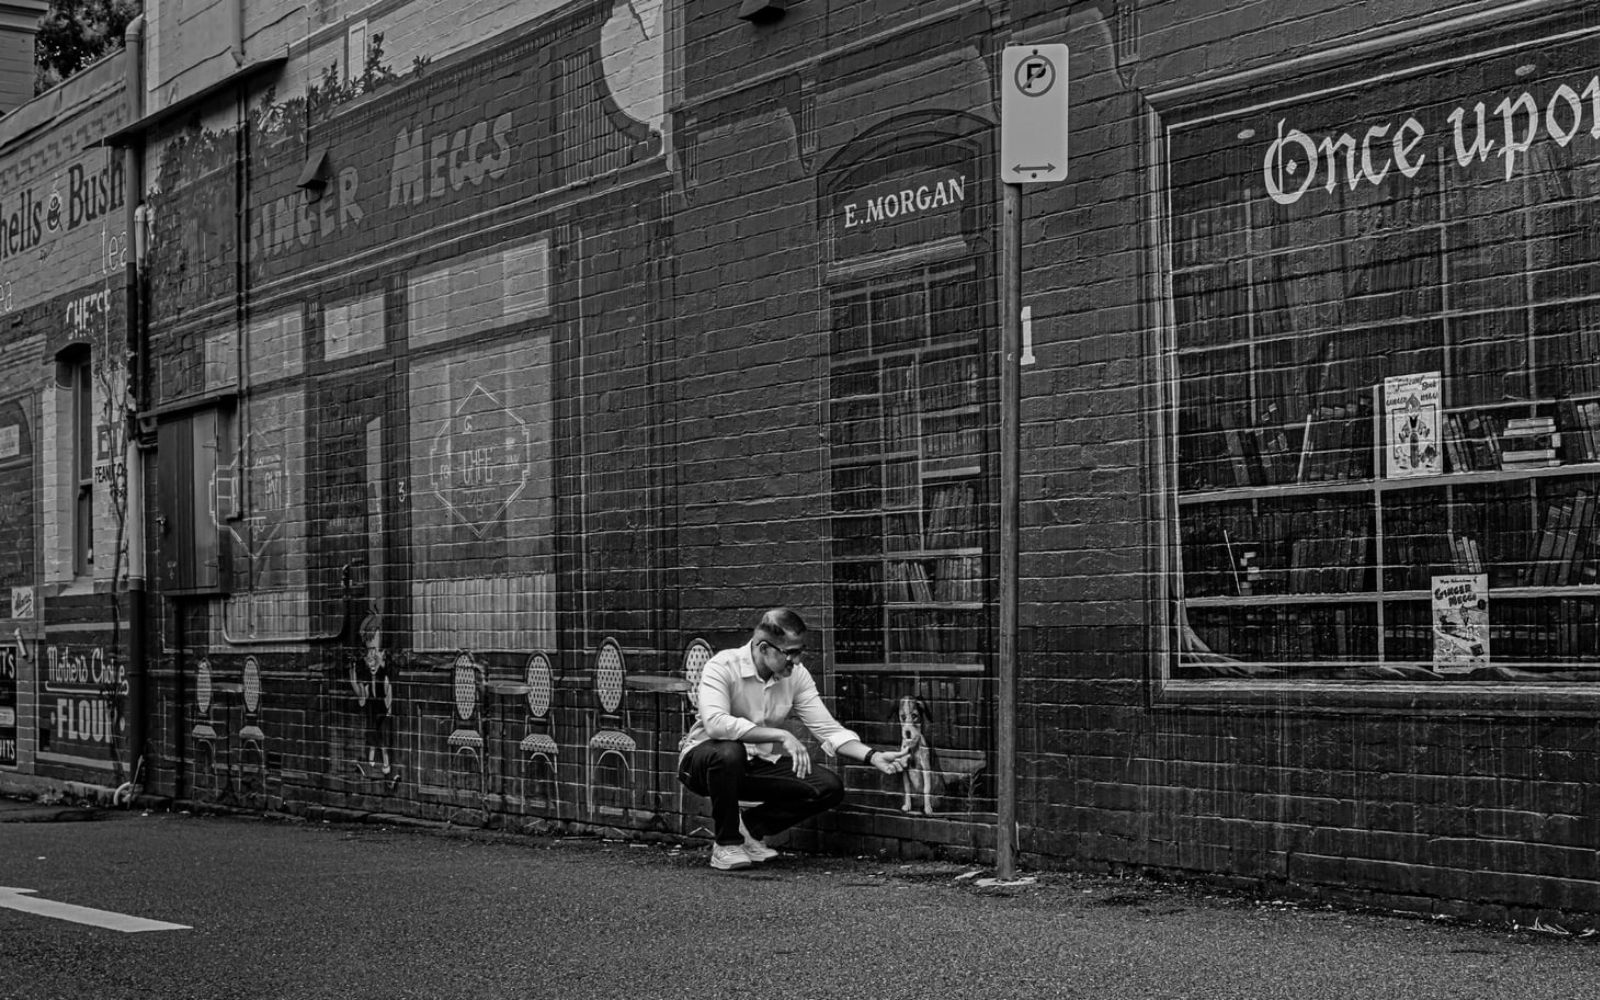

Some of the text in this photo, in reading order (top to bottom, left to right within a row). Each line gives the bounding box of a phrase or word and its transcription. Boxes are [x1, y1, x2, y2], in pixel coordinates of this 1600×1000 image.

[67, 160, 126, 231] Bush
[388, 111, 516, 209] MEGGS
[1263, 117, 1426, 205] Once
[92, 647, 125, 684] Choie
